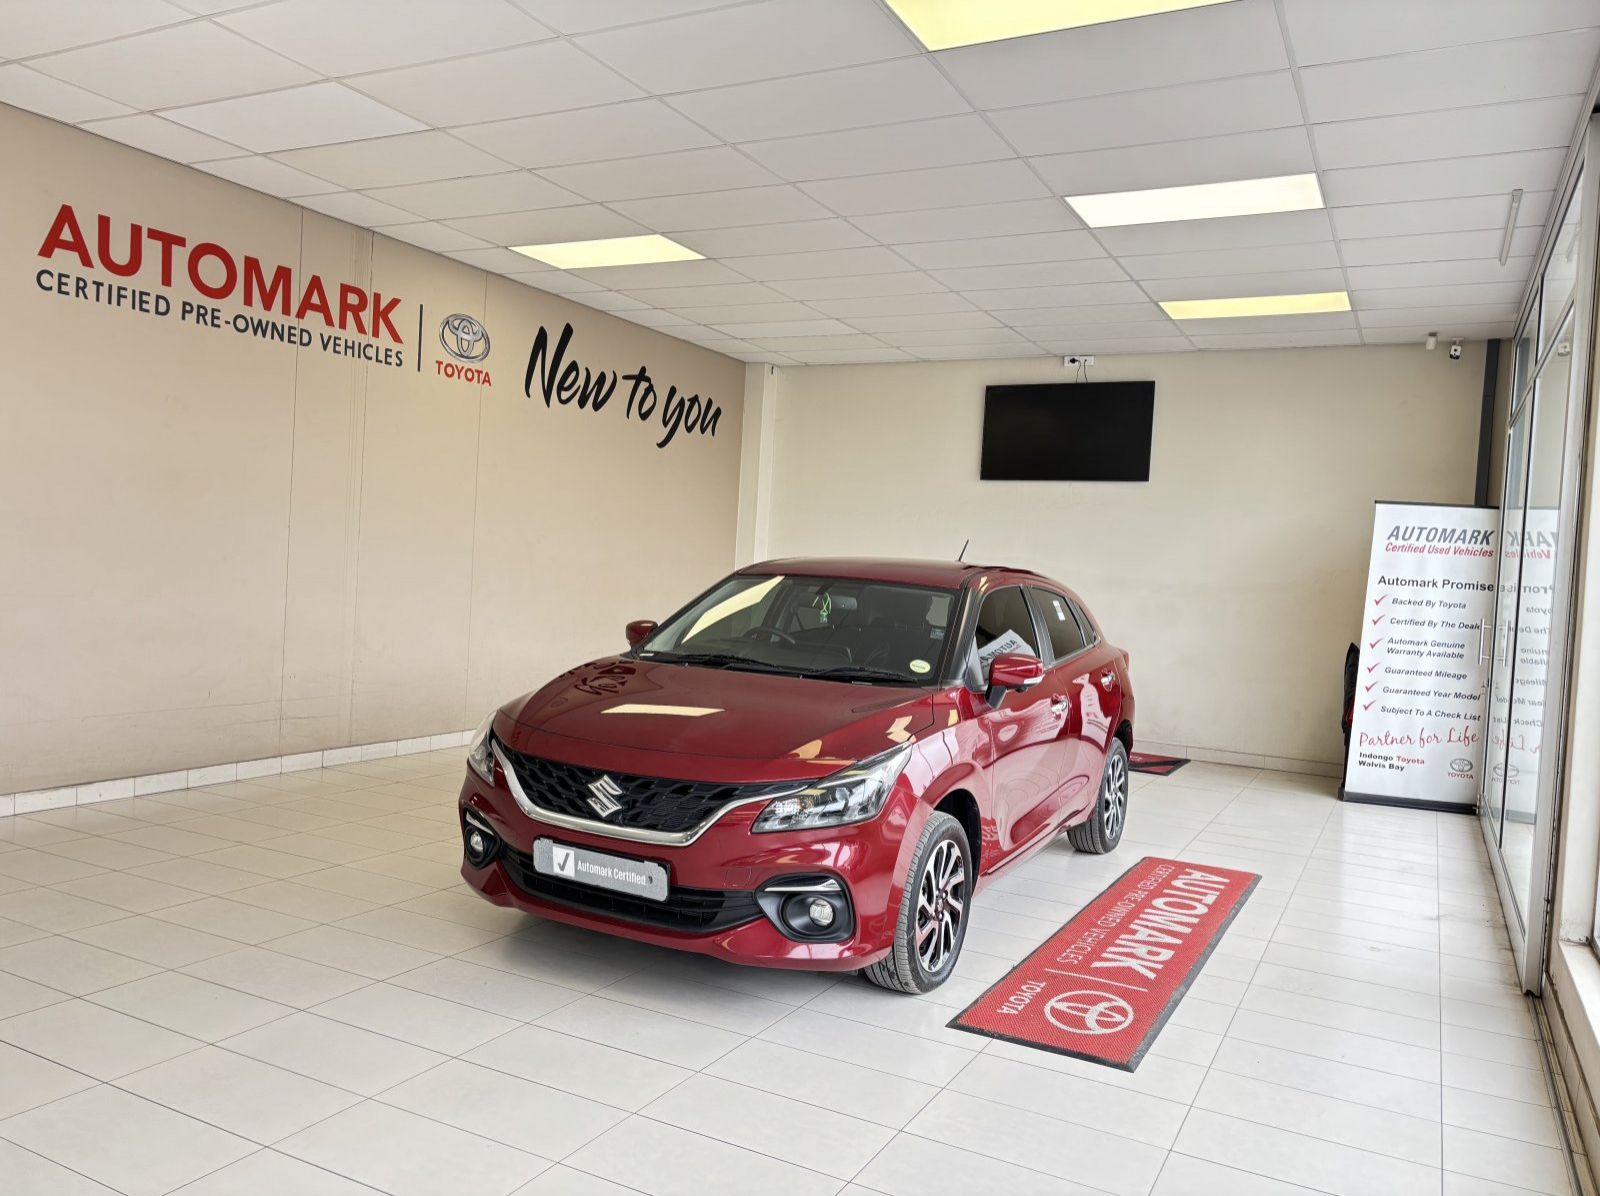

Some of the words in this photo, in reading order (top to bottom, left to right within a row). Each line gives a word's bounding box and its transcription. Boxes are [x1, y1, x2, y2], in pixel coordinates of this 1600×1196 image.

[37, 203, 404, 344] AUTOMARK
[36, 268, 171, 316] CERTIFIED
[181, 301, 313, 347] PRE-OWNED
[320, 332, 403, 368] VEHICLES
[435, 359, 492, 387] TOYOTA
[524, 322, 617, 412] New
[621, 365, 657, 421] to
[656, 385, 722, 449] you
[1387, 525, 1495, 546] AUTOMARK
[1385, 542, 1425, 554] Certified
[1427, 544, 1451, 556] Used
[1453, 546, 1494, 558] Vehicles
[1377, 575, 1438, 589] Automark
[1442, 579, 1494, 592] Promise
[1391, 597, 1423, 607] Backed
[1425, 599, 1436, 609] By
[1438, 600, 1467, 610] Toyota
[1390, 617, 1426, 627] Certified
[1427, 619, 1439, 629] By
[1440, 620, 1456, 629] The
[1387, 637, 1428, 648] Automark
[1430, 640, 1466, 650] Genuine
[1387, 647, 1425, 659] Warranty
[1426, 649, 1465, 660] Available
[1384, 667, 1433, 678] Guaranteed
[1435, 669, 1468, 681] Mileage
[1382, 686, 1432, 697] Guaranteed
[1433, 689, 1452, 699] Year
[1453, 691, 1481, 701] Model
[1380, 705, 1413, 717] Subject
[1415, 709, 1425, 717] To
[1435, 710, 1461, 720] Check
[1463, 712, 1481, 721] List
[1359, 731, 1415, 747] Partner
[1418, 728, 1442, 748] for
[1446, 725, 1480, 747] Life
[1358, 760, 1386, 769] Walvis
[1388, 763, 1405, 772] Bay
[1359, 752, 1394, 762] Indongo
[1396, 756, 1425, 765] Toyota
[1447, 772, 1474, 780] TOYOTA
[577, 860, 612, 876] Automark
[613, 868, 646, 886] Certified
[1089, 867, 1230, 980] AUTOMARK
[996, 980, 1047, 1014] TOYOTA
